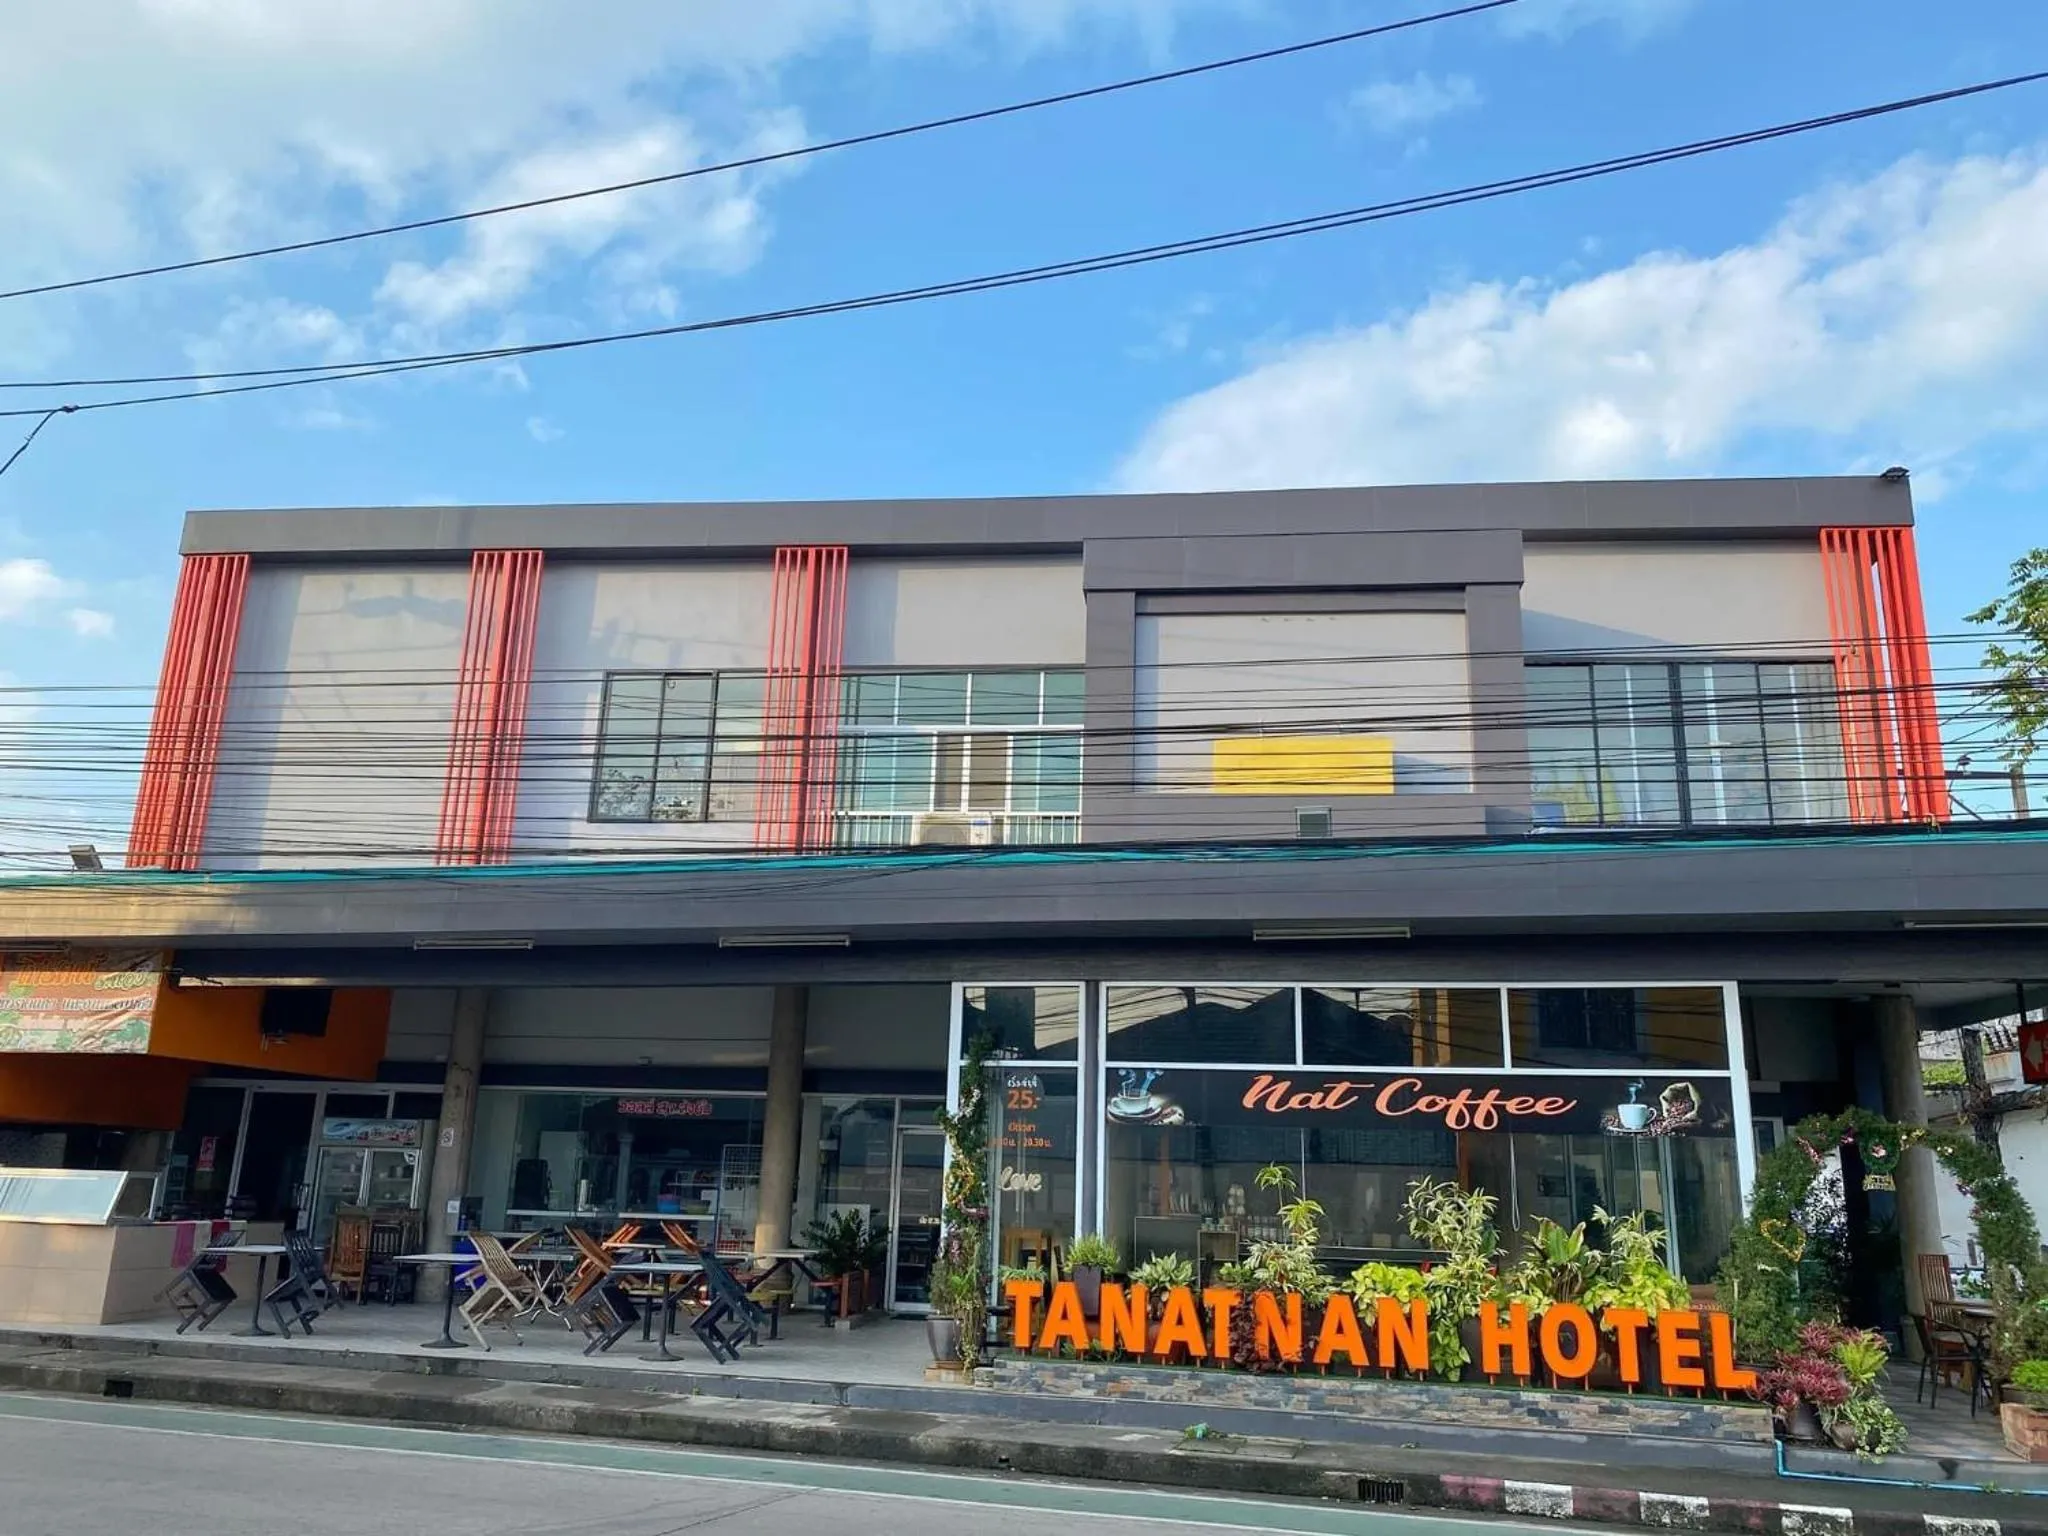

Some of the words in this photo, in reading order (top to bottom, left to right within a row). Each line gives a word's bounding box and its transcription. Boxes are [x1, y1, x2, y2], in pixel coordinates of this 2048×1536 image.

[1242, 1074, 1375, 1113] Nat
[1375, 1077, 1577, 1131] Coffee
[1004, 1279, 1429, 1370] TANATNAN
[1480, 1299, 1757, 1389] HOTEL
